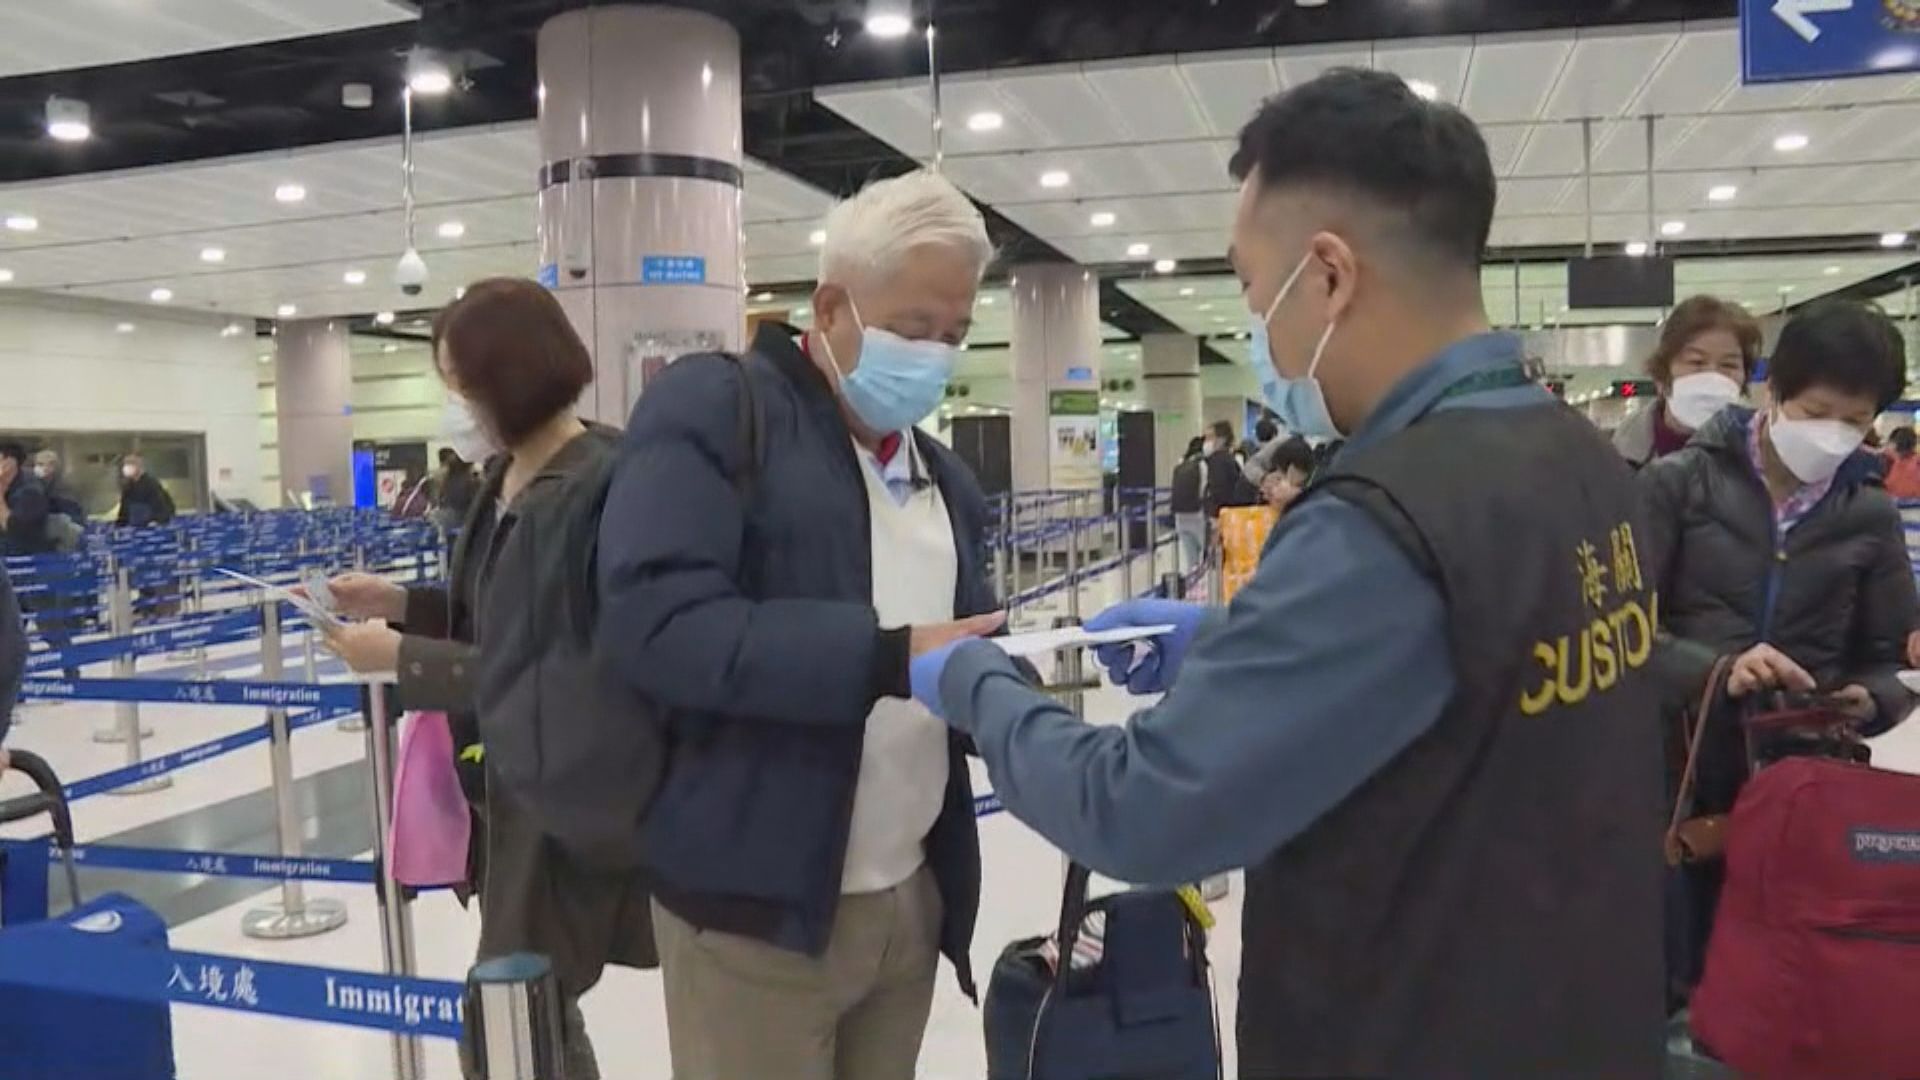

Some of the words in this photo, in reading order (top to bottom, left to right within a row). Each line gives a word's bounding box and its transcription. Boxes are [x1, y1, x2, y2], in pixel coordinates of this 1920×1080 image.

[1577, 522, 1643, 607] 海關
[1521, 591, 1657, 715] CUSTO
[243, 686, 320, 703] Immigration
[254, 859, 330, 876] Immigration
[167, 963, 258, 1006] 入境處
